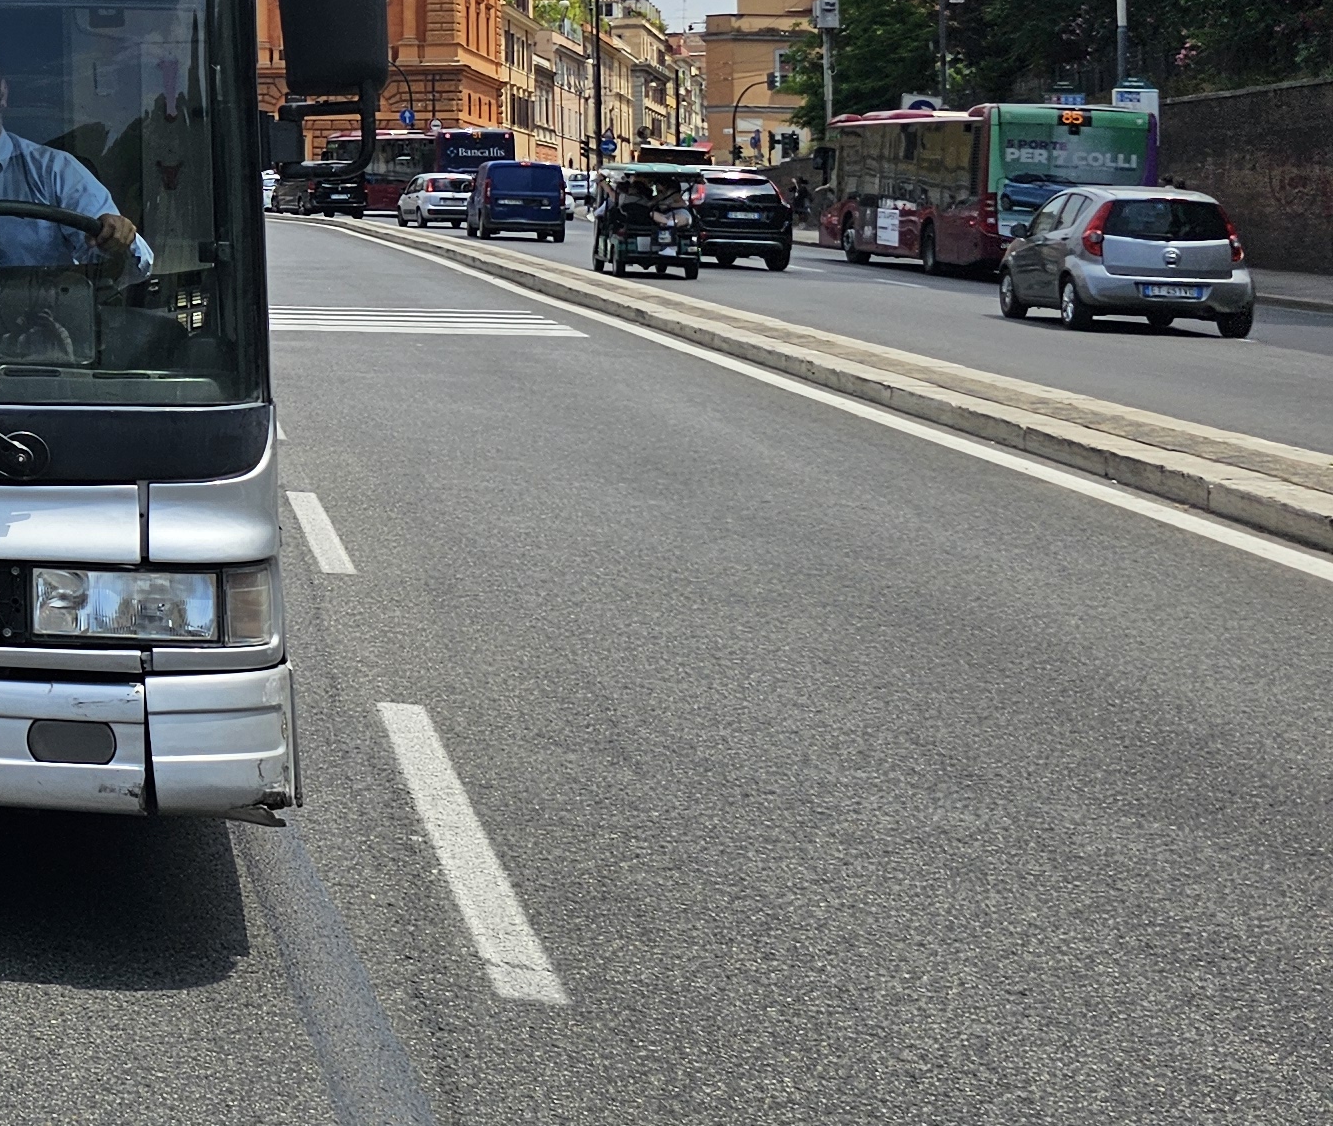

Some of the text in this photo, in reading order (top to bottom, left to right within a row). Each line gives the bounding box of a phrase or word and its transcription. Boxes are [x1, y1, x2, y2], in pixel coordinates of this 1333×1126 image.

[1061, 110, 1084, 124] 85
[1017, 139, 1068, 151] PORTE
[458, 147, 489, 157] Banca
[1005, 147, 1049, 164] PER
[1052, 149, 1068, 165] 7
[1073, 151, 1138, 169] COLLI
